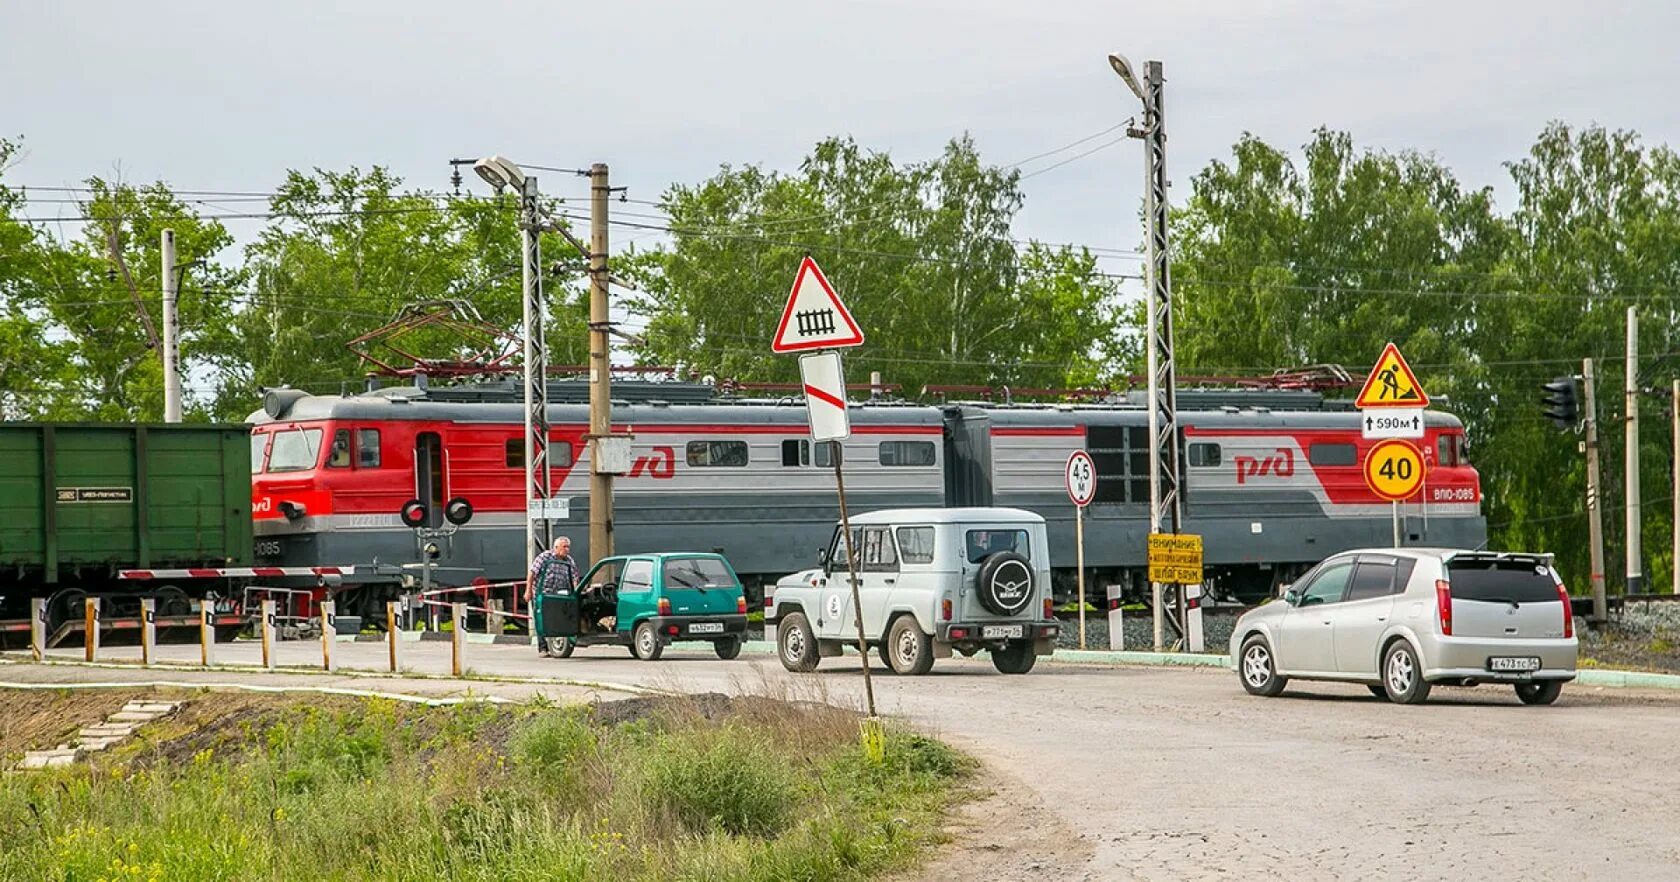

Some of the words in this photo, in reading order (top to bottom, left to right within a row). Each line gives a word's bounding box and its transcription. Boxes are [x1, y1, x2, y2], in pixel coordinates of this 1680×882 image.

[1377, 417, 1410, 429] 590м
[1073, 463, 1090, 482] 4,5
[1379, 457, 1412, 480] 40
